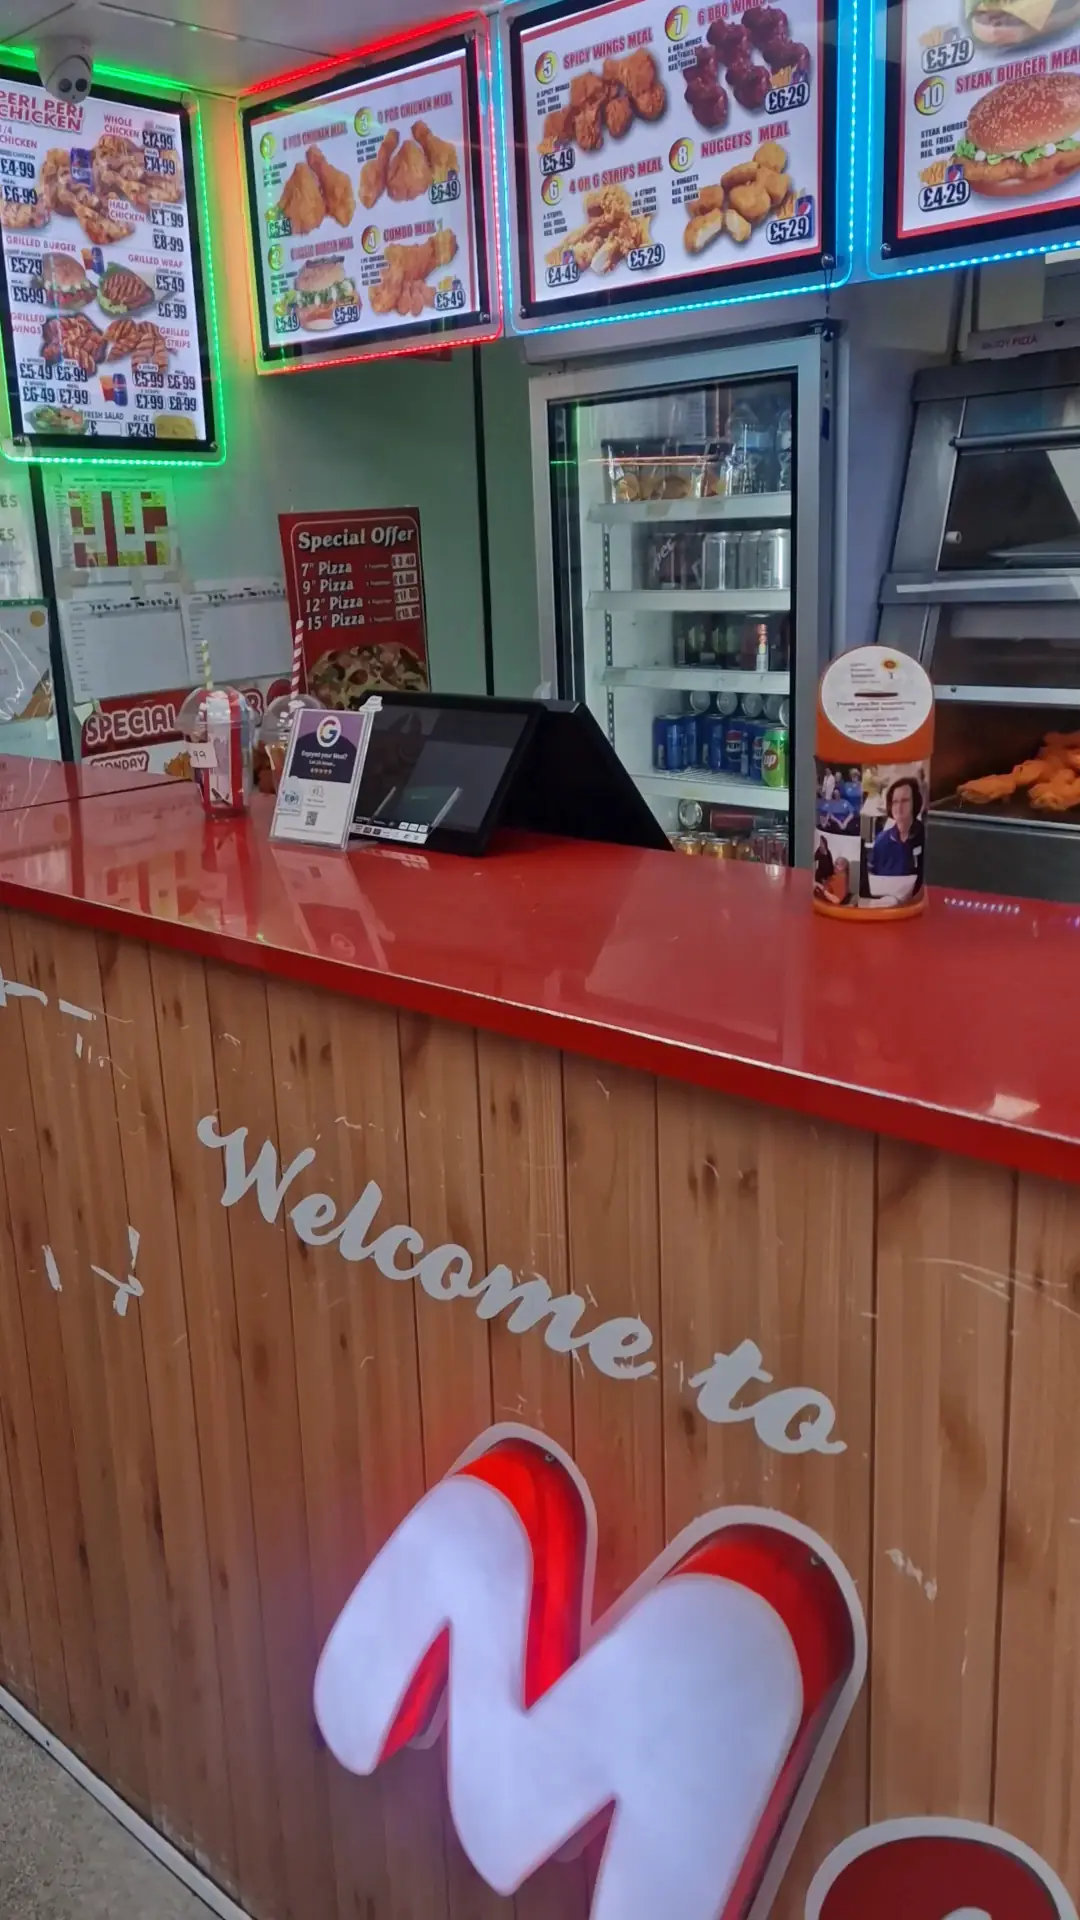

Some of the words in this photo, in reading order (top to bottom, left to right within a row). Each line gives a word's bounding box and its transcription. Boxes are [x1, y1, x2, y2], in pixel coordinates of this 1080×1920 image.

[673, 13, 683, 35] 7
[563, 50, 591, 70] SPICY
[592, 39, 625, 61] WINGS
[627, 28, 654, 50] MEAL
[927, 40, 969, 70] £5.79
[542, 56, 554, 79] 5
[955, 71, 993, 94] STEAK
[996, 56, 1047, 83] BURGER
[1051, 43, 1080, 72] MEA
[769, 84, 807, 110] £6.29
[922, 82, 945, 110] 10
[0, 104, 81, 131] CHICKEN
[44, 99, 83, 118] PERI
[104, 114, 132, 127] WHOLE
[104, 125, 140, 138] CHICKEN
[701, 130, 752, 158] NUGGETS
[758, 120, 790, 143] MEAL
[921, 127, 941, 139] STEAK
[942, 121, 968, 135] BURGER
[0, 135, 37, 148] CHICKEN
[936, 135, 953, 147] FRIES
[936, 144, 956, 156] DRINK
[543, 149, 573, 173] £5.49
[678, 143, 689, 167] 8
[1, 158, 35, 179] £4.99
[144, 155, 175, 175] £14.99
[569, 180, 576, 194] 4
[578, 176, 591, 193] OR
[602, 164, 635, 186] STRIPS
[638, 155, 663, 174] MEAL
[4, 186, 37, 205] £6.99
[431, 181, 457, 201] £6.49
[548, 180, 559, 200] 6
[923, 181, 966, 208] £4.29
[109, 201, 129, 210] HALF
[110, 210, 144, 222] CHICKEN
[384, 224, 413, 242] COMBO
[770, 215, 808, 241] £5.29
[6, 235, 40, 247] GRILLED
[44, 241, 77, 252] BURGER
[153, 234, 184, 252] £8.99
[128, 254, 159, 266] GRILLED
[161, 260, 184, 268] WRAP
[630, 245, 662, 267] £5.29
[10, 256, 43, 276] £5.29
[548, 262, 578, 284] £4.49
[156, 274, 185, 293] £5.49
[12, 285, 44, 304] £6.99
[436, 291, 464, 309] £5.49
[12, 312, 45, 321] GRILLED
[158, 303, 187, 319] £6.99
[335, 306, 359, 323] £5.99
[160, 327, 190, 336] GRILLED
[1012, 334, 1038, 346] PIZZA
[167, 340, 190, 349] STRIPS
[20, 363, 53, 380] £5.49
[57, 367, 88, 382] £6.99
[134, 371, 164, 389] £5.99
[168, 375, 196, 390] £6.99
[23, 387, 55, 403] £6.49
[59, 390, 89, 404] £7.99
[169, 396, 197, 412] £8.99
[84, 411, 102, 419] FRESH
[104, 412, 124, 420] SALAD
[298, 528, 366, 551] Special
[371, 526, 415, 547] Offer
[318, 561, 352, 576] Pizza
[320, 579, 353, 593] Pizza
[306, 597, 325, 613] 12"
[329, 596, 363, 611] Pizza
[308, 615, 327, 631] 15"
[331, 613, 365, 628] Pizza
[86, 704, 175, 745] SPECIAL
[320, 720, 337, 744] G
[197, 1115, 656, 1379] Welcome
[688, 1338, 848, 1454] to
